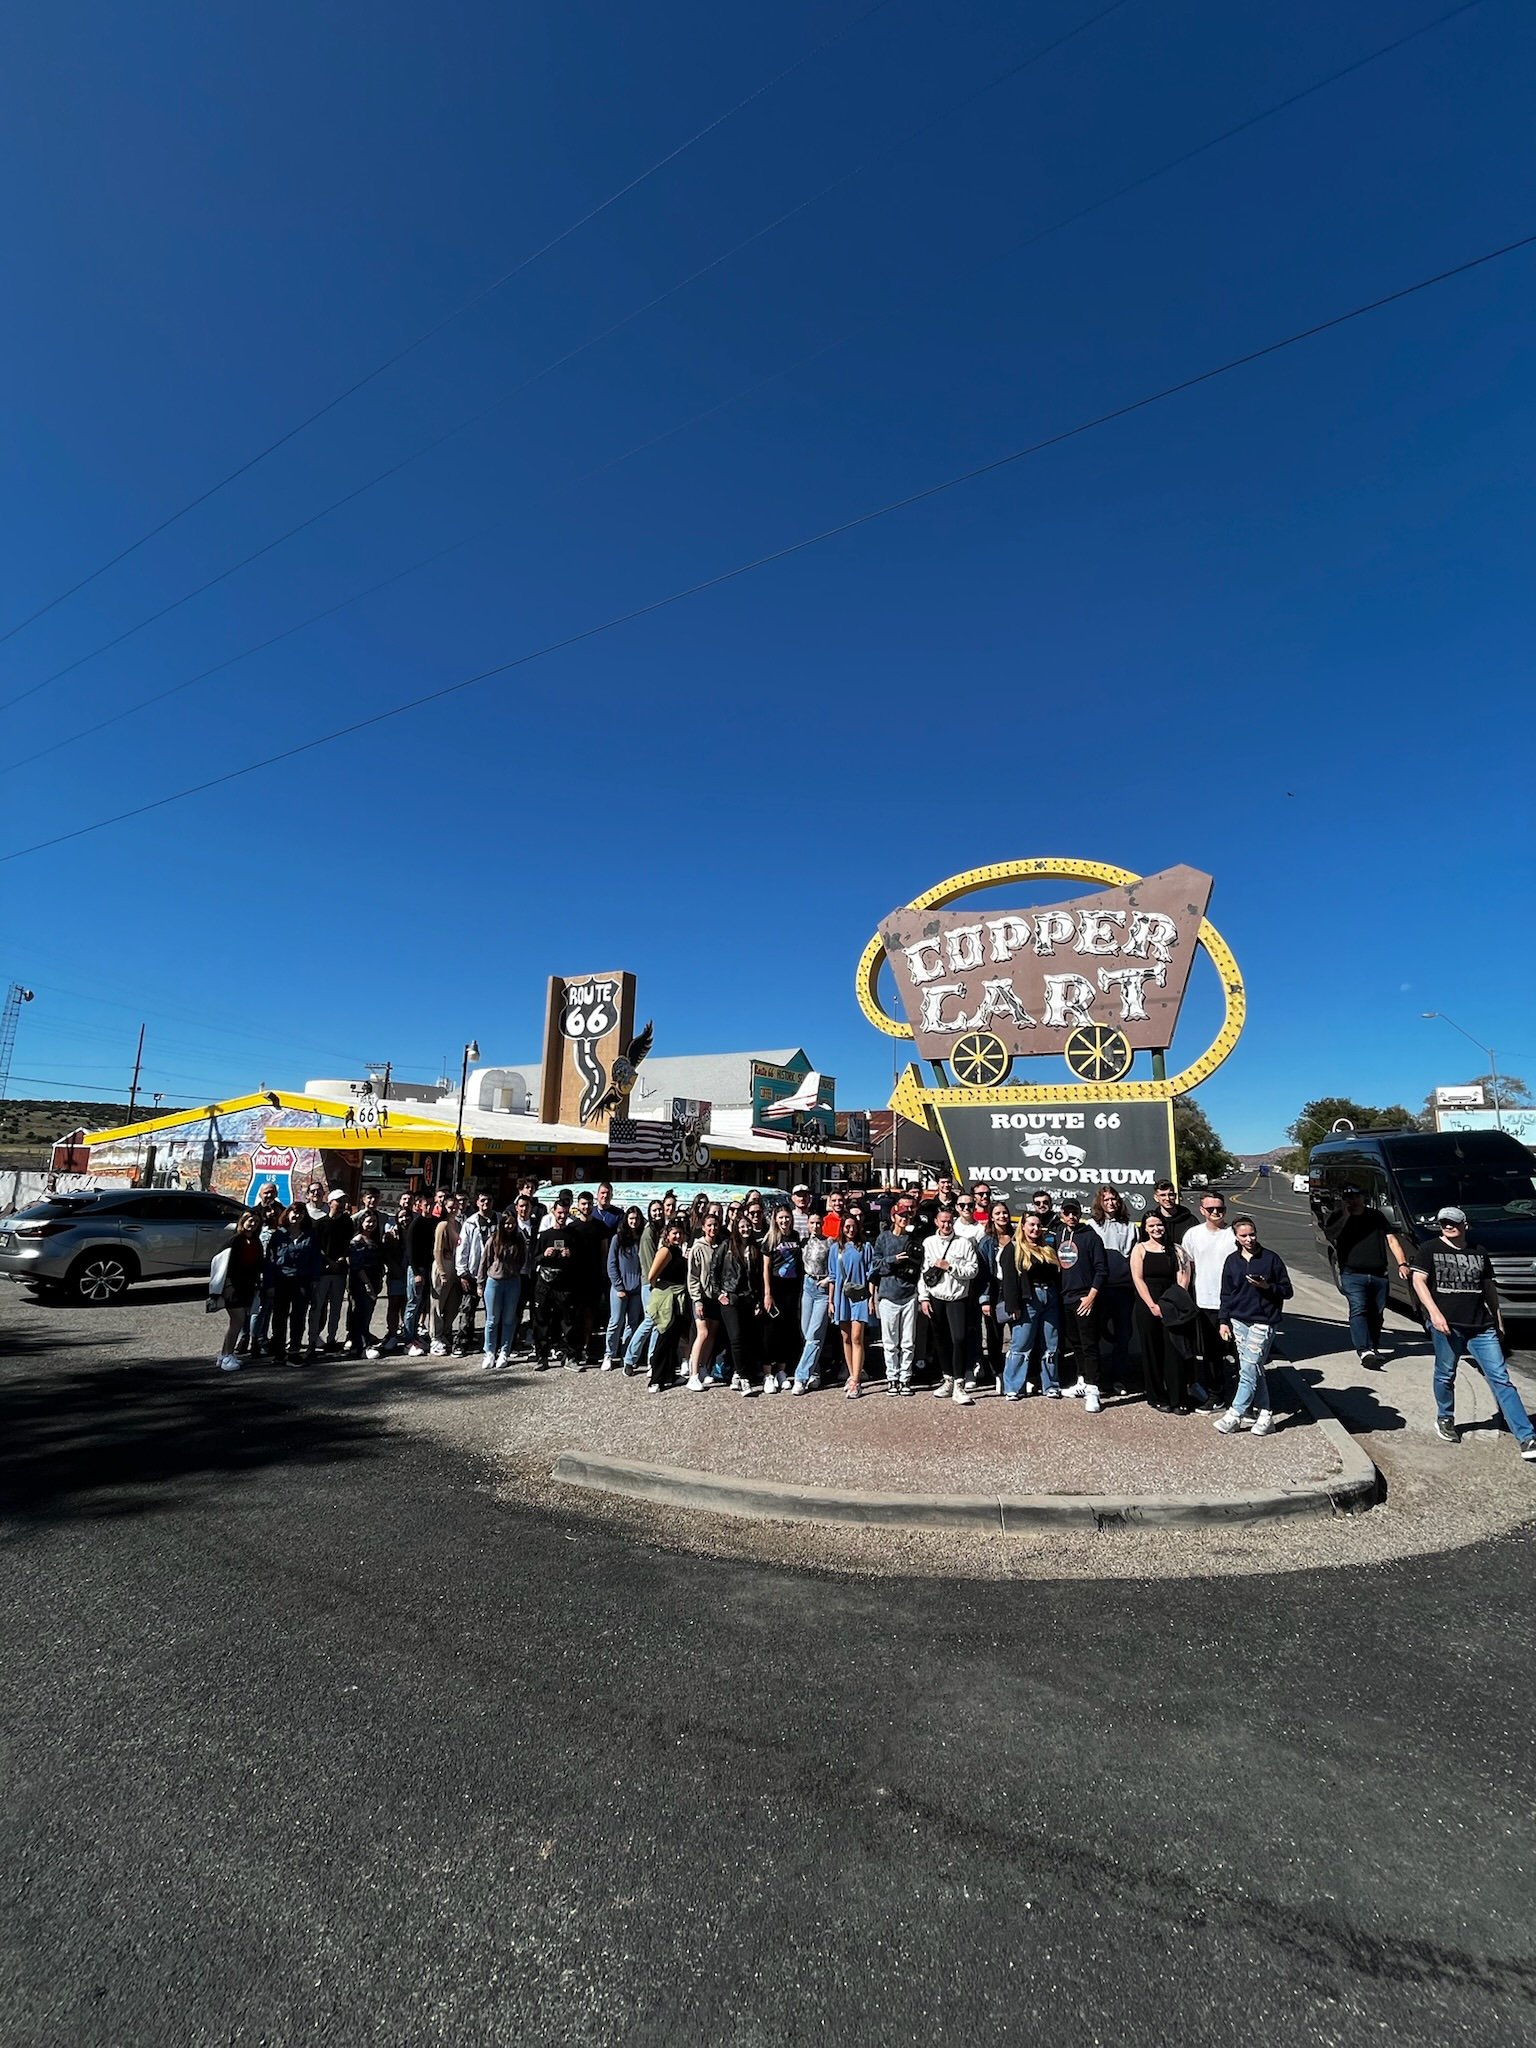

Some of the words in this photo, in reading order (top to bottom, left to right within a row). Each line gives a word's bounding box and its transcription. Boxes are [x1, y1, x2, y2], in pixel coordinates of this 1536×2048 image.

[902, 910, 1179, 985] COPPER
[569, 983, 612, 1006] ROUTE
[920, 962, 1168, 1034] CART
[566, 1003, 609, 1036] 66
[360, 1107, 374, 1122] 66
[990, 1112, 1085, 1129] ROUTE
[1094, 1112, 1121, 1129] 66
[1043, 1138, 1064, 1146] ROUTE
[255, 1153, 291, 1167] HISTORIC
[1044, 1146, 1064, 1160] 66
[266, 1174, 277, 1183] US
[968, 1165, 1156, 1185] MOTOPORIUM
[1062, 1190, 1078, 1199] Cars
